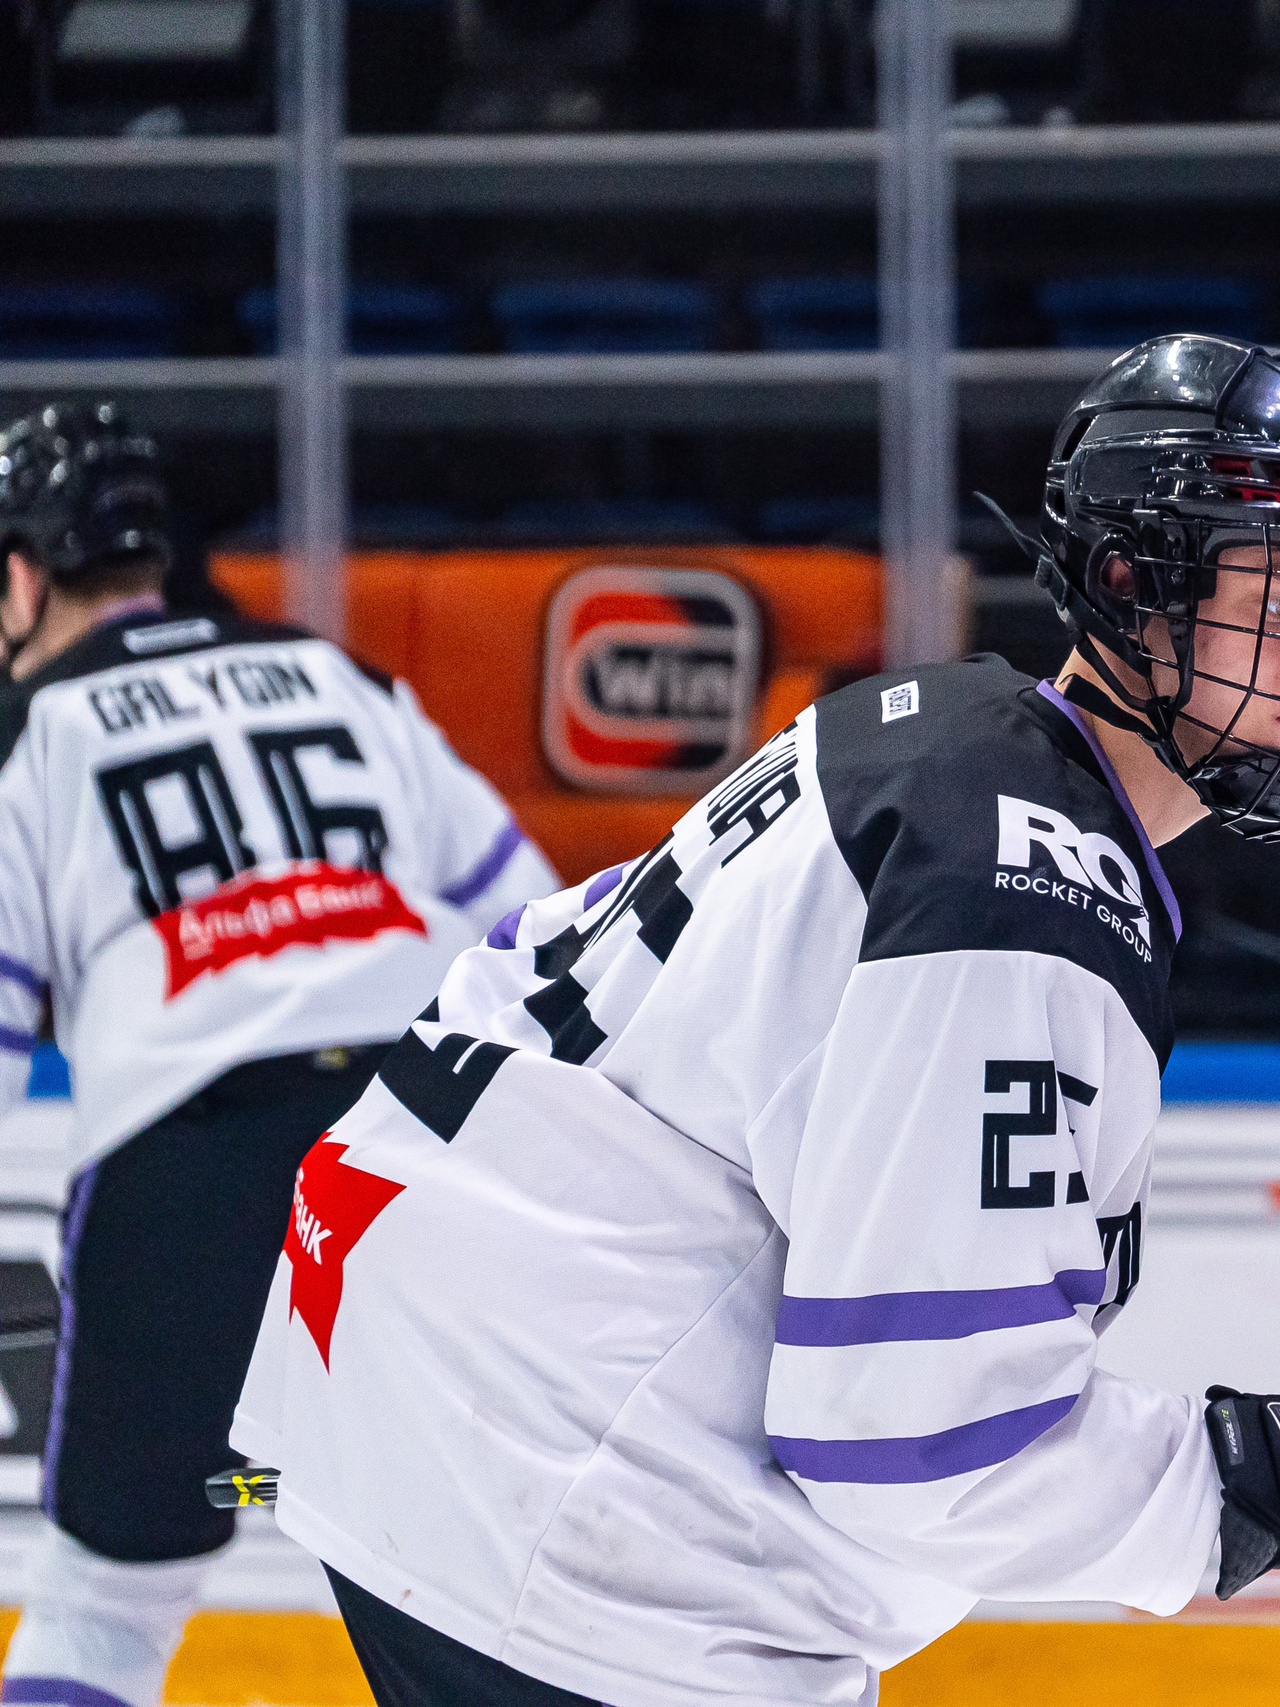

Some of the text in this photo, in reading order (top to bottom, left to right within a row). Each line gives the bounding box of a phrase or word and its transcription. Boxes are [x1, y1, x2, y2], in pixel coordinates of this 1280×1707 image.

[95, 723, 389, 920] 86
[995, 872, 1152, 963] ROCKET GROUP
